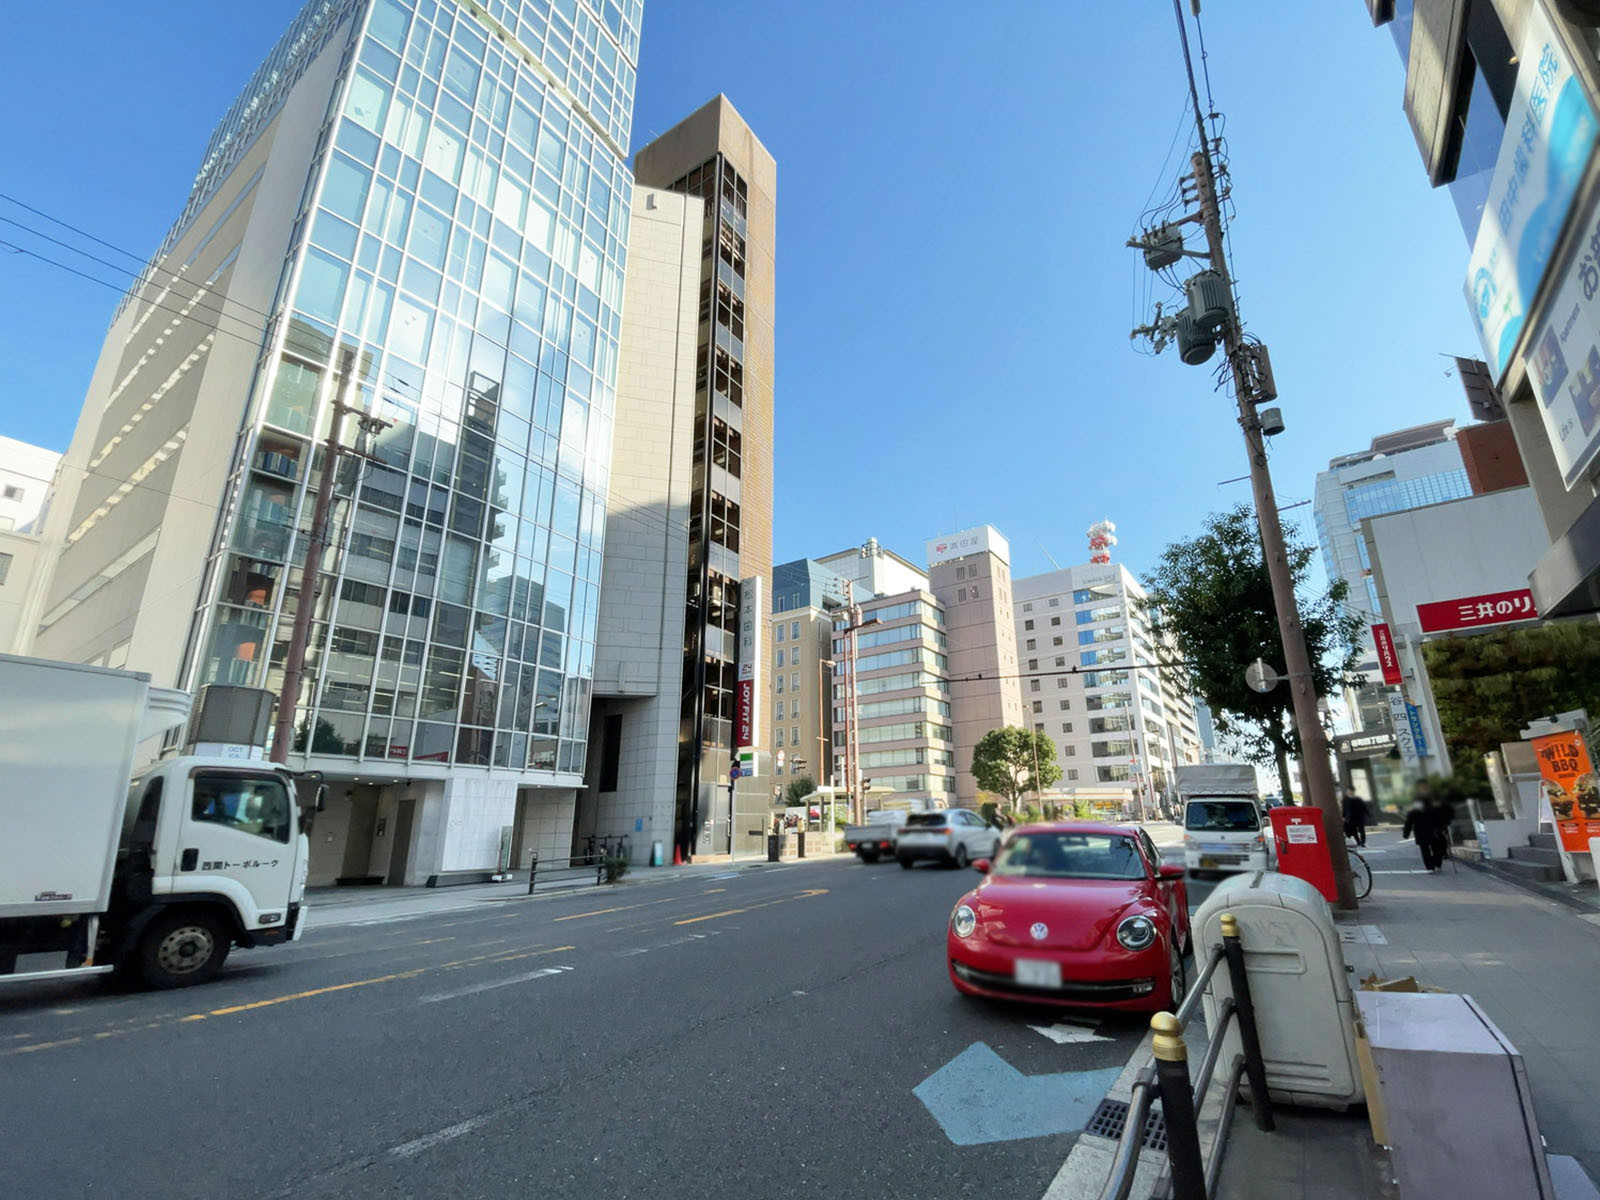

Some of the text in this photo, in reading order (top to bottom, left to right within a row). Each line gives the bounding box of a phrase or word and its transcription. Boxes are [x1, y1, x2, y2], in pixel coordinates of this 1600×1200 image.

[1458, 597, 1537, 622] 三井のリ
[1542, 743, 1579, 760] WILD
[1552, 758, 1579, 772] BBQ
